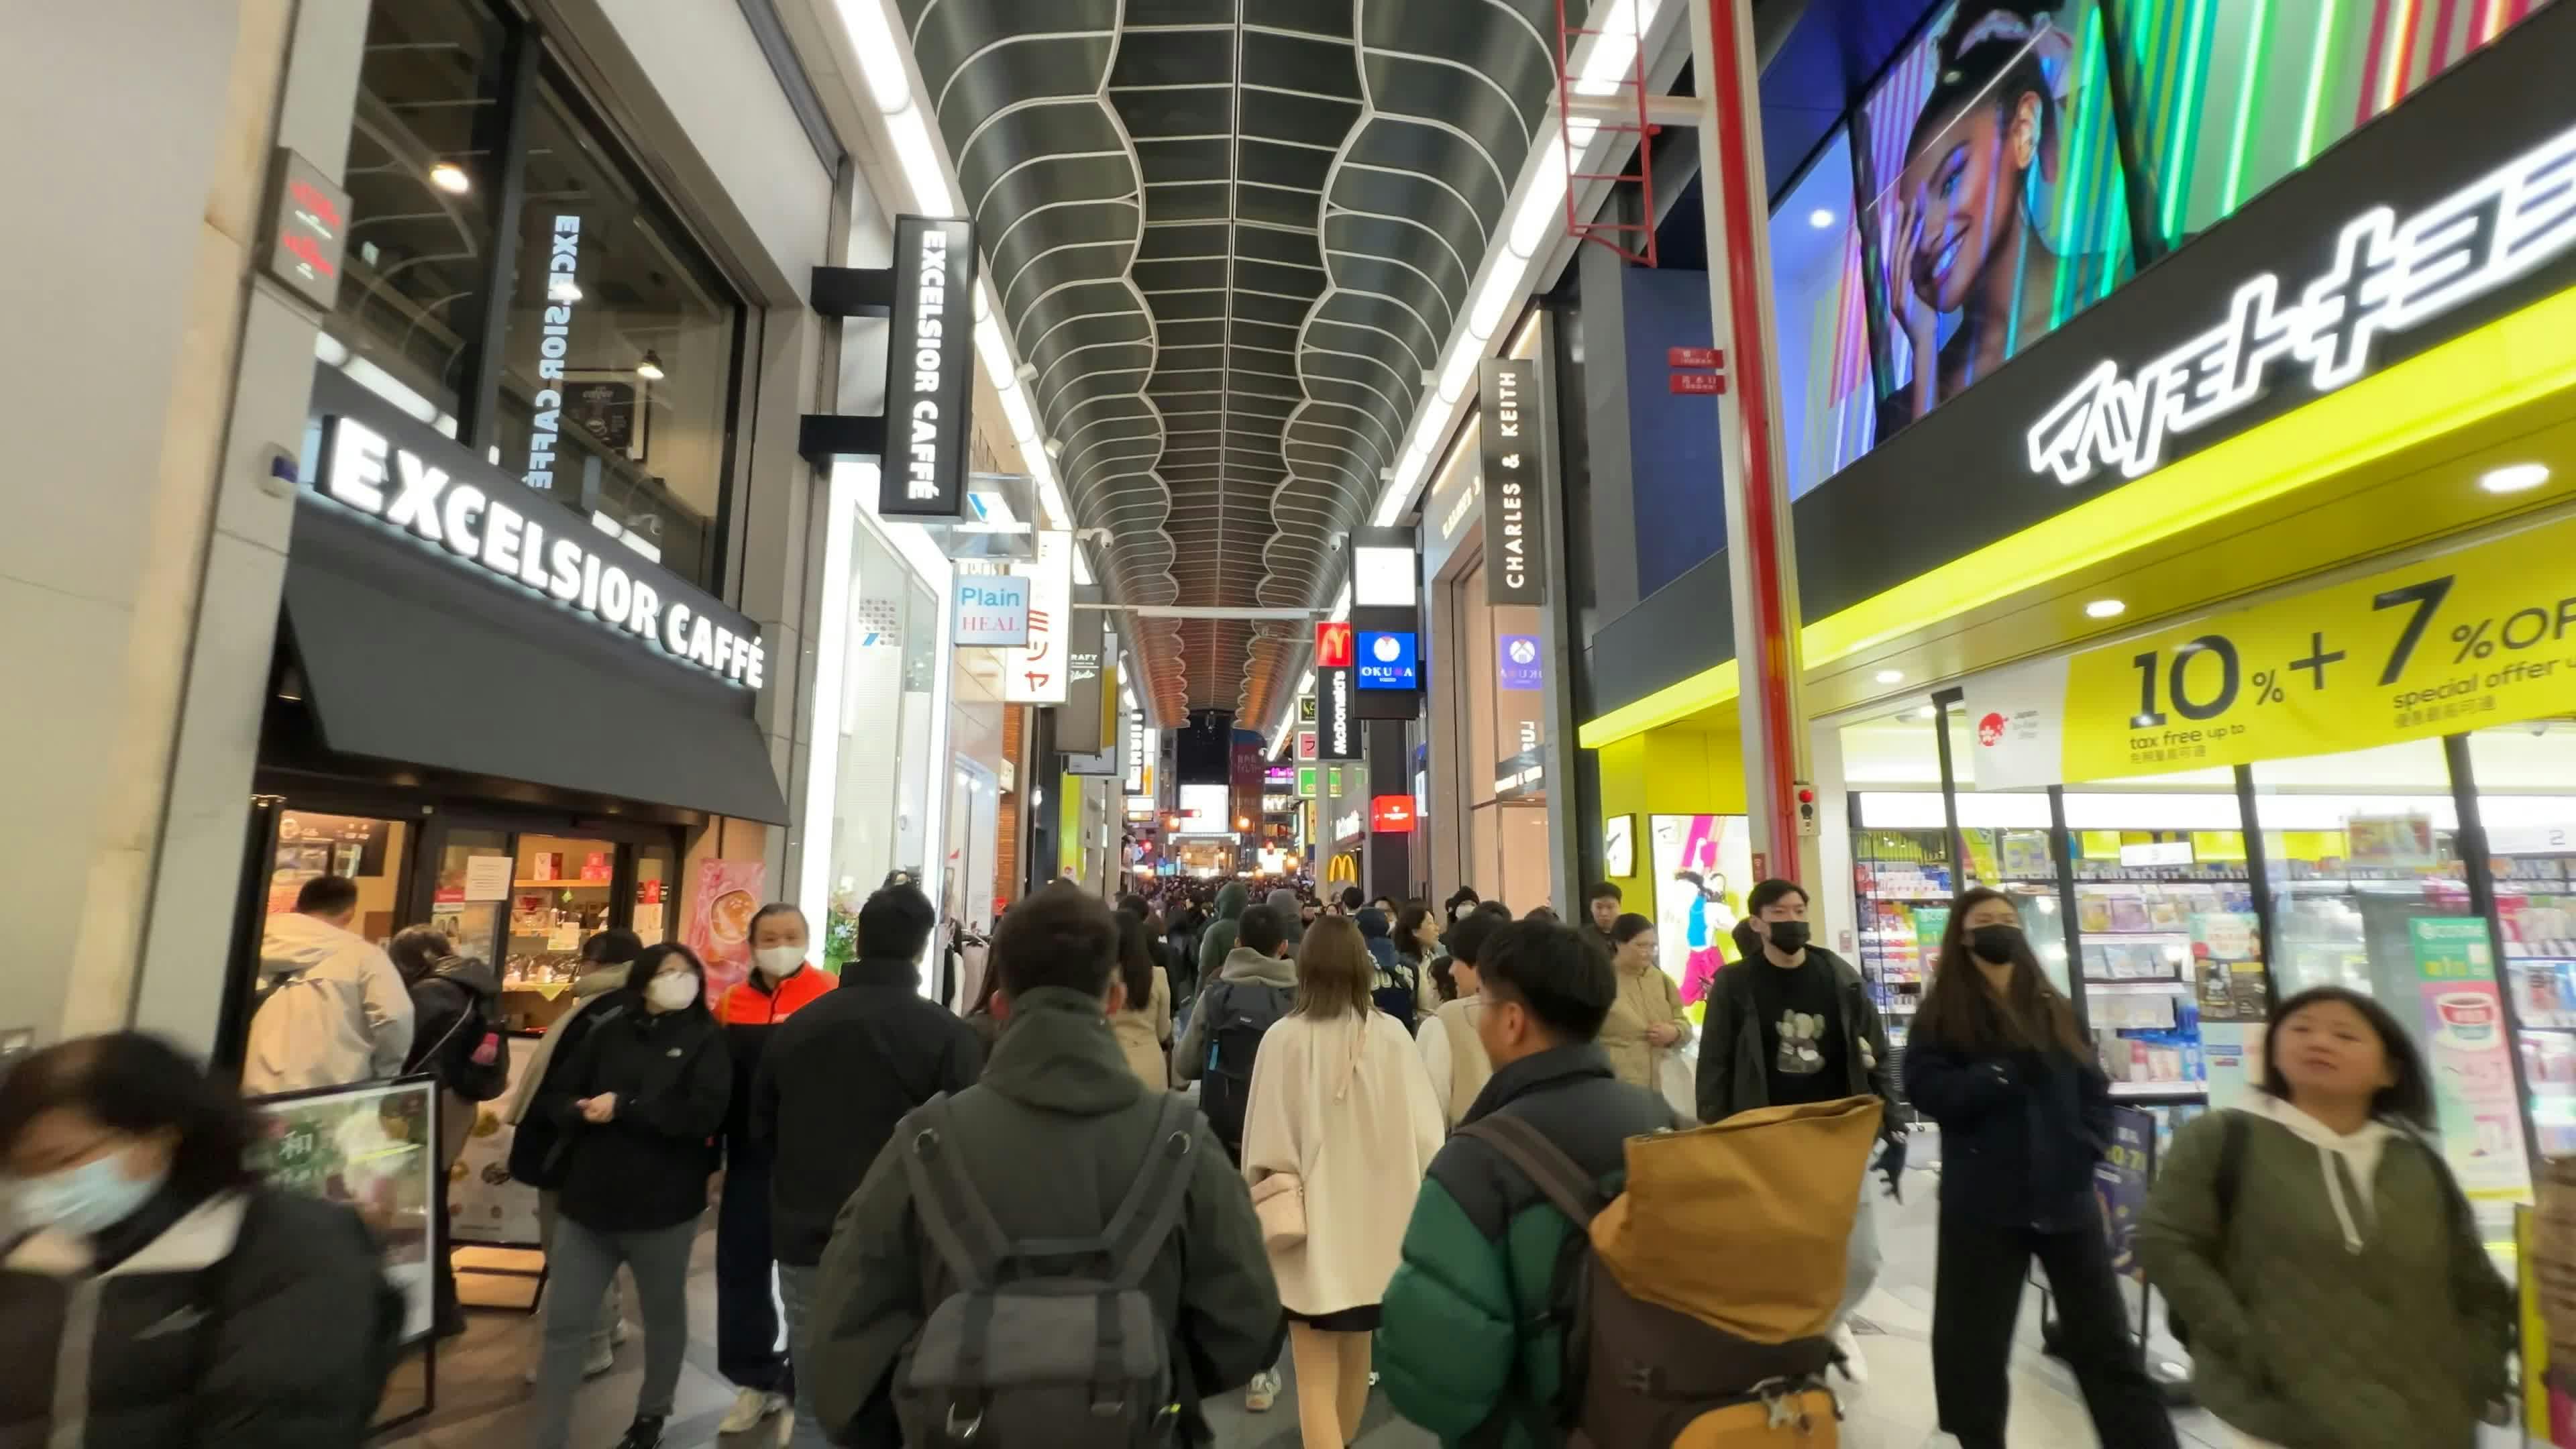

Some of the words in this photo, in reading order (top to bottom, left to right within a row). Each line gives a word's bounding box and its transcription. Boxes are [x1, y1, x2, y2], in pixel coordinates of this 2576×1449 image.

[914, 230, 947, 392] EXCELSIOR
[1499, 372, 1519, 437] KEITH
[1502, 453, 1520, 468] &
[330, 417, 659, 639] EXCELSIOR
[1503, 482, 1525, 588] CHARLES
[961, 587, 1020, 607] Plain
[963, 616, 1020, 632] HEAL
[1024, 608, 1050, 692] ミツヤ
[2393, 672, 2478, 711] special
[2484, 659, 2561, 688] offer
[2129, 736, 2159, 750] tax
[2163, 730, 2202, 746] free
[2206, 727, 2229, 740] up
[2231, 723, 2245, 735] to
